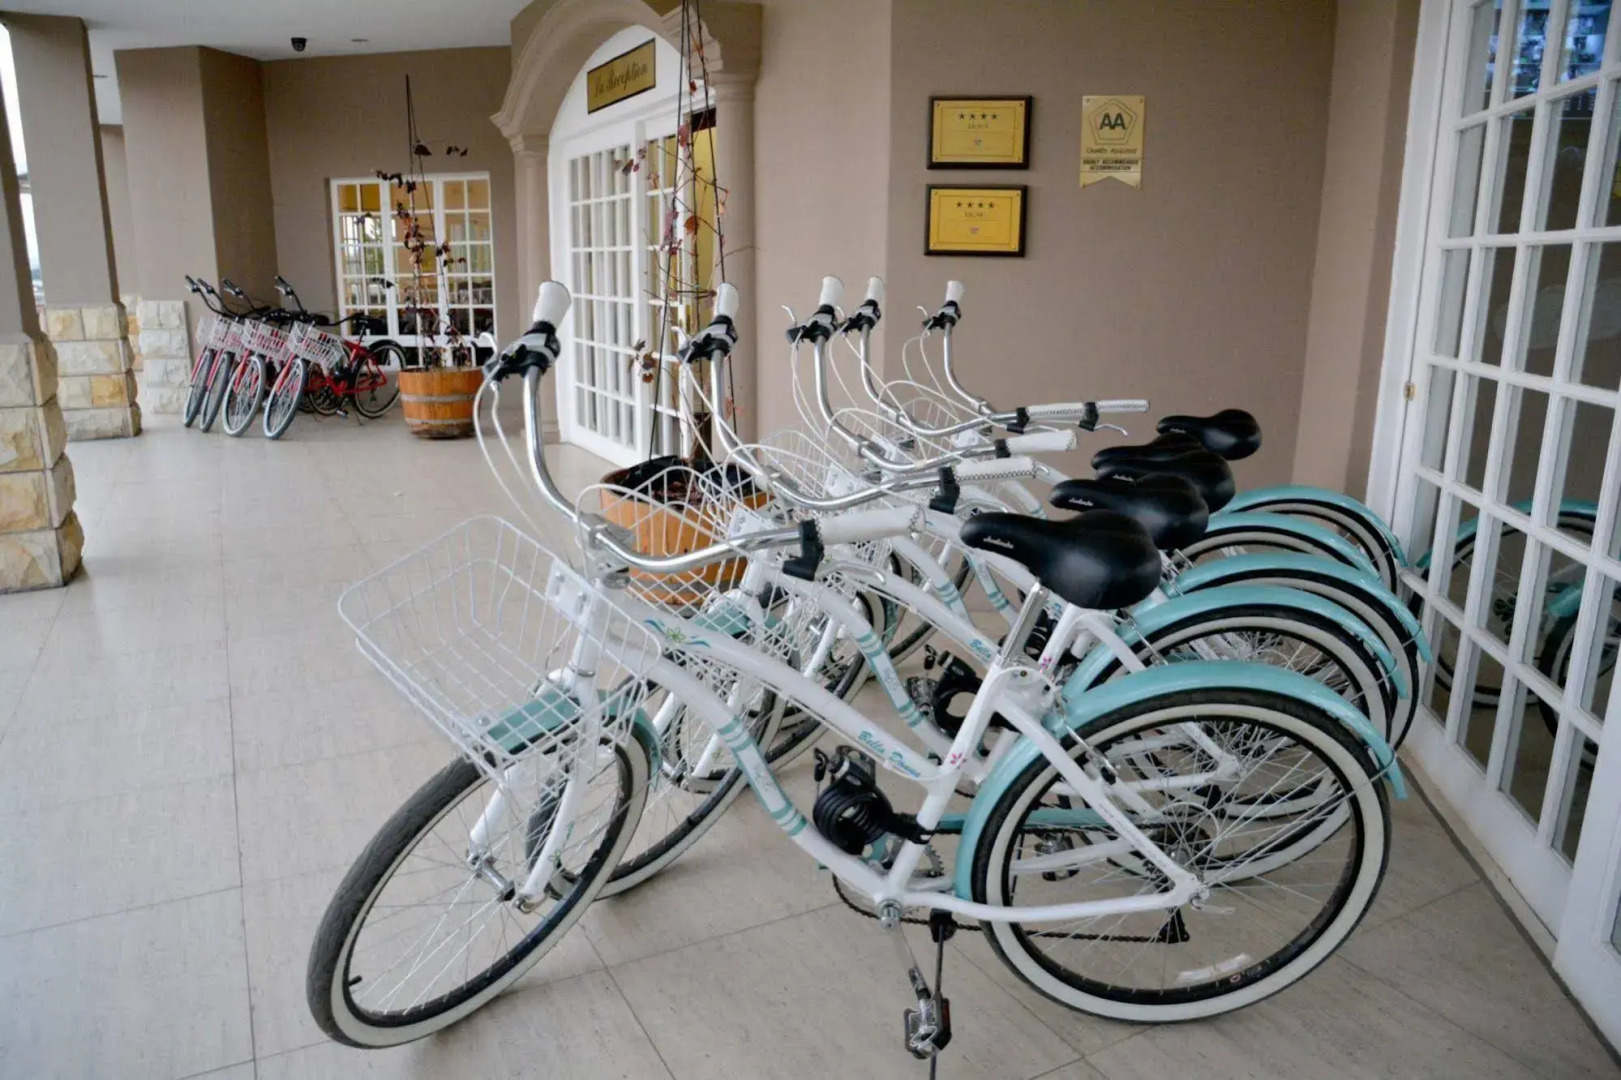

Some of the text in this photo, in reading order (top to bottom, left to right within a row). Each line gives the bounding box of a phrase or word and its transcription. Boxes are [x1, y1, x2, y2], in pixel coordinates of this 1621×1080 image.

[605, 61, 648, 91] Reception
[1099, 112, 1126, 130] AA
[1086, 147, 1138, 155] Quality Assured
[858, 730, 886, 754] Bella
